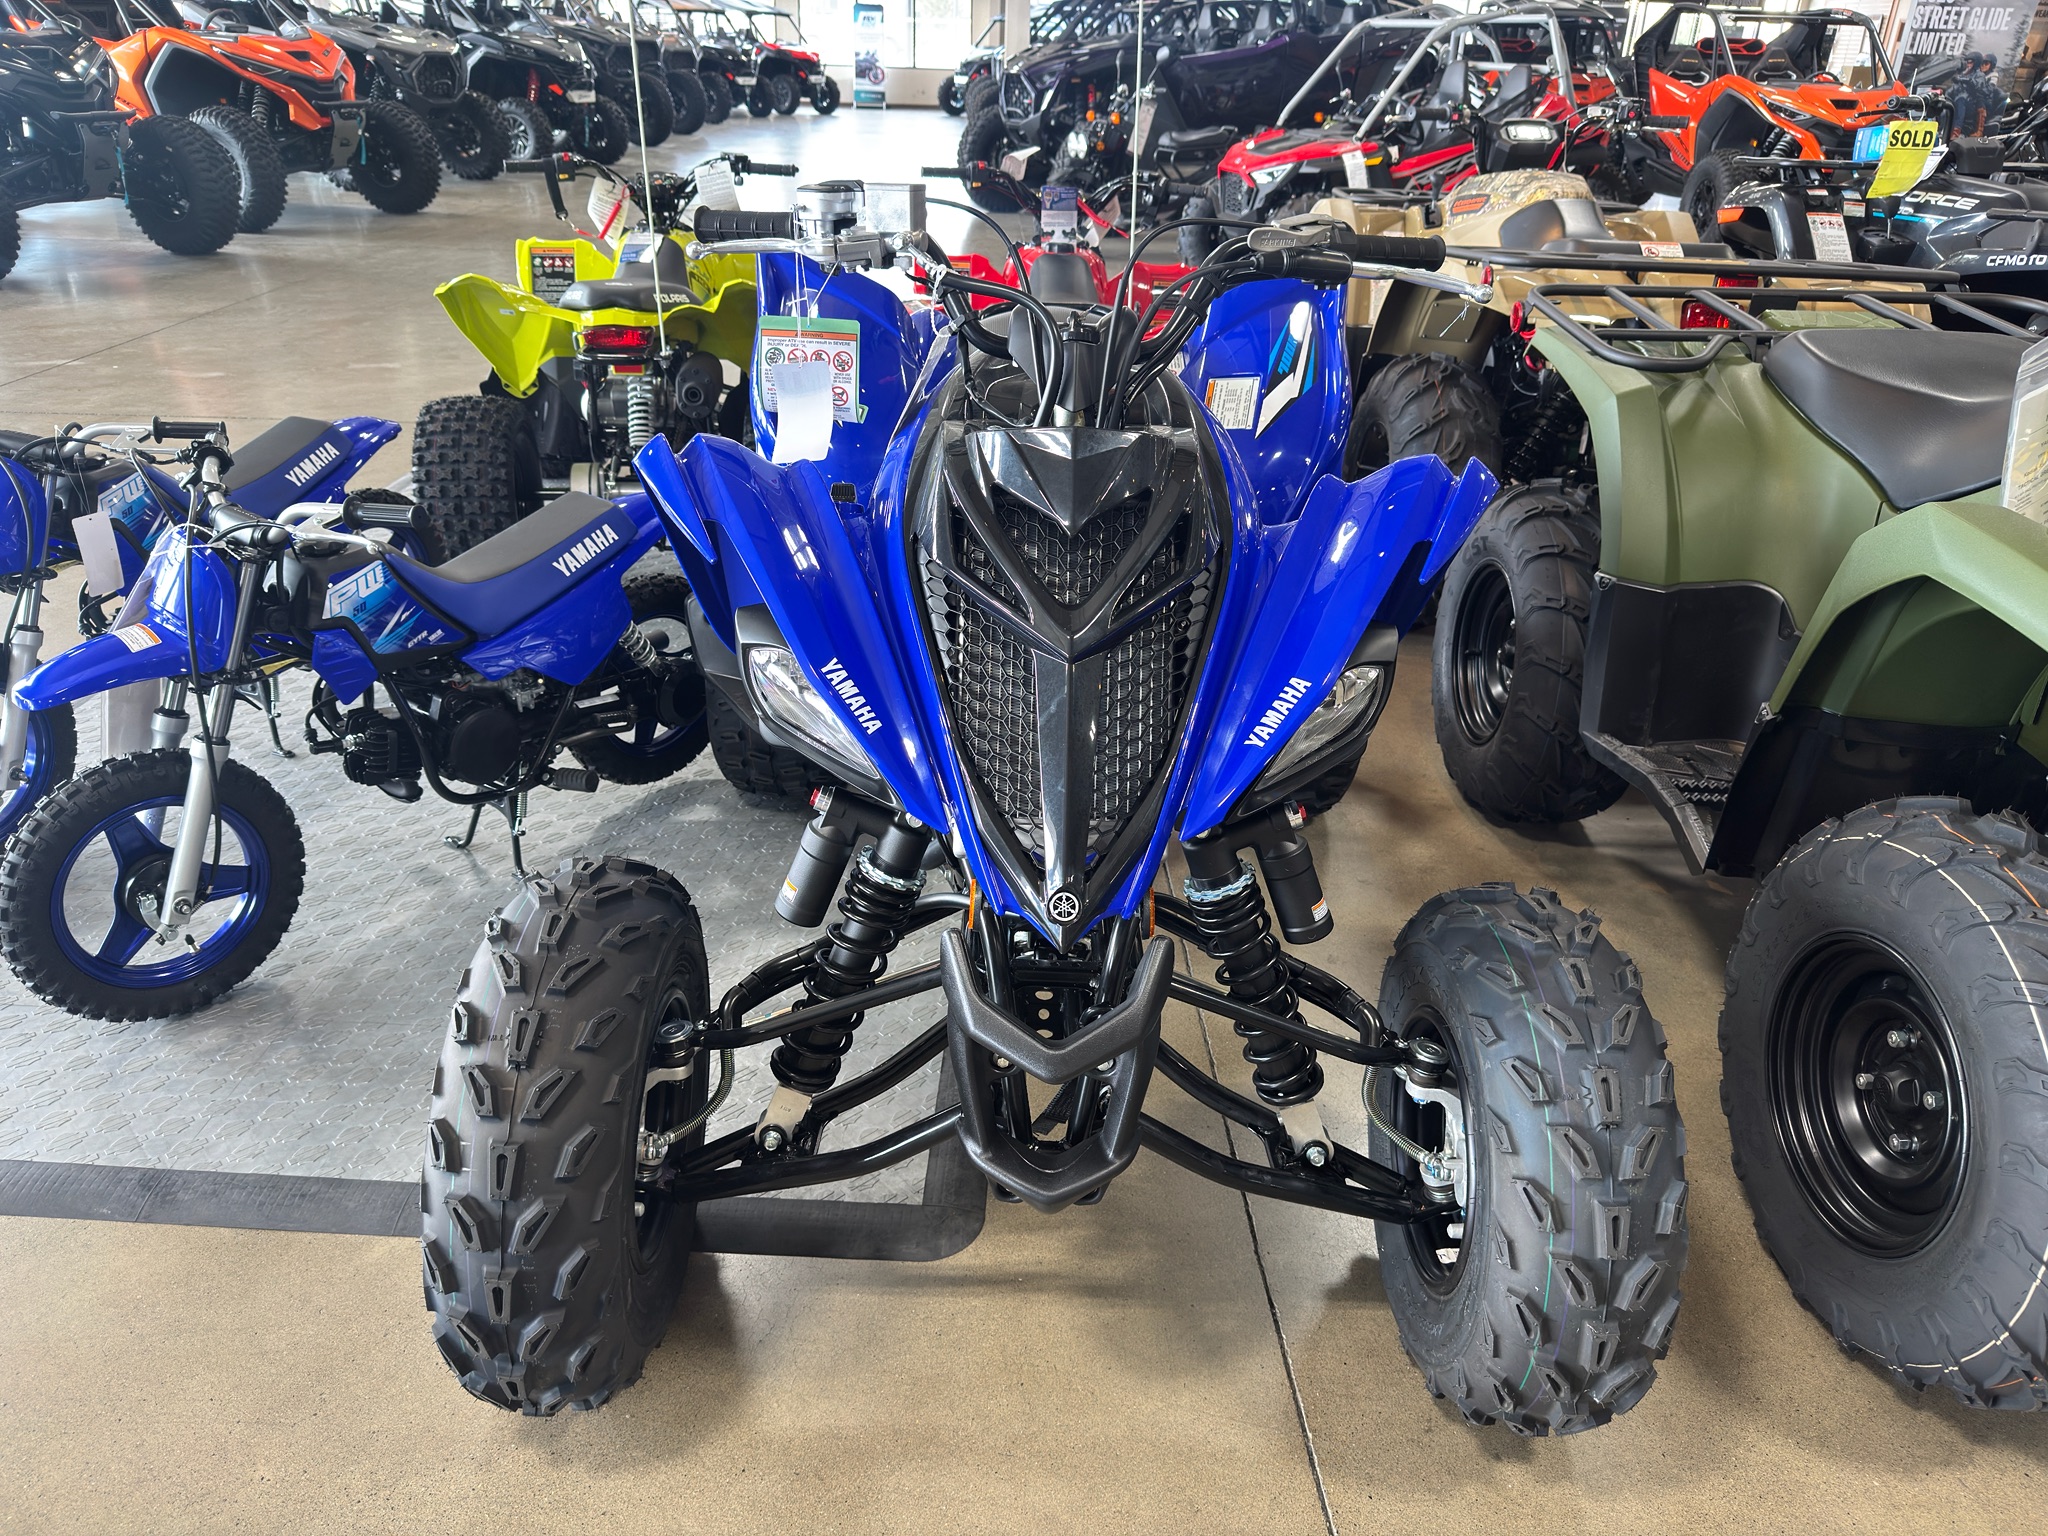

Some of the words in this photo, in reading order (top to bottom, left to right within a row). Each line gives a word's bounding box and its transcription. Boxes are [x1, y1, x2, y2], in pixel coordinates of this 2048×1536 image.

[1911, 5, 1969, 30] STREET
[1968, 7, 2015, 31] GLIDE
[1905, 31, 1967, 56] LIMITED
[1889, 130, 1934, 148] SOLD
[1904, 190, 1981, 210] ORCE
[1985, 254, 2048, 267] CFMOTO
[652, 293, 691, 303] POLARIS
[284, 441, 341, 488] YAMAHA
[121, 505, 134, 518] 50
[552, 523, 619, 577] YAMAHA
[352, 603, 367, 618] 50
[820, 657, 883, 735] YAMAHA
[1243, 677, 1312, 748] YAMAHA
